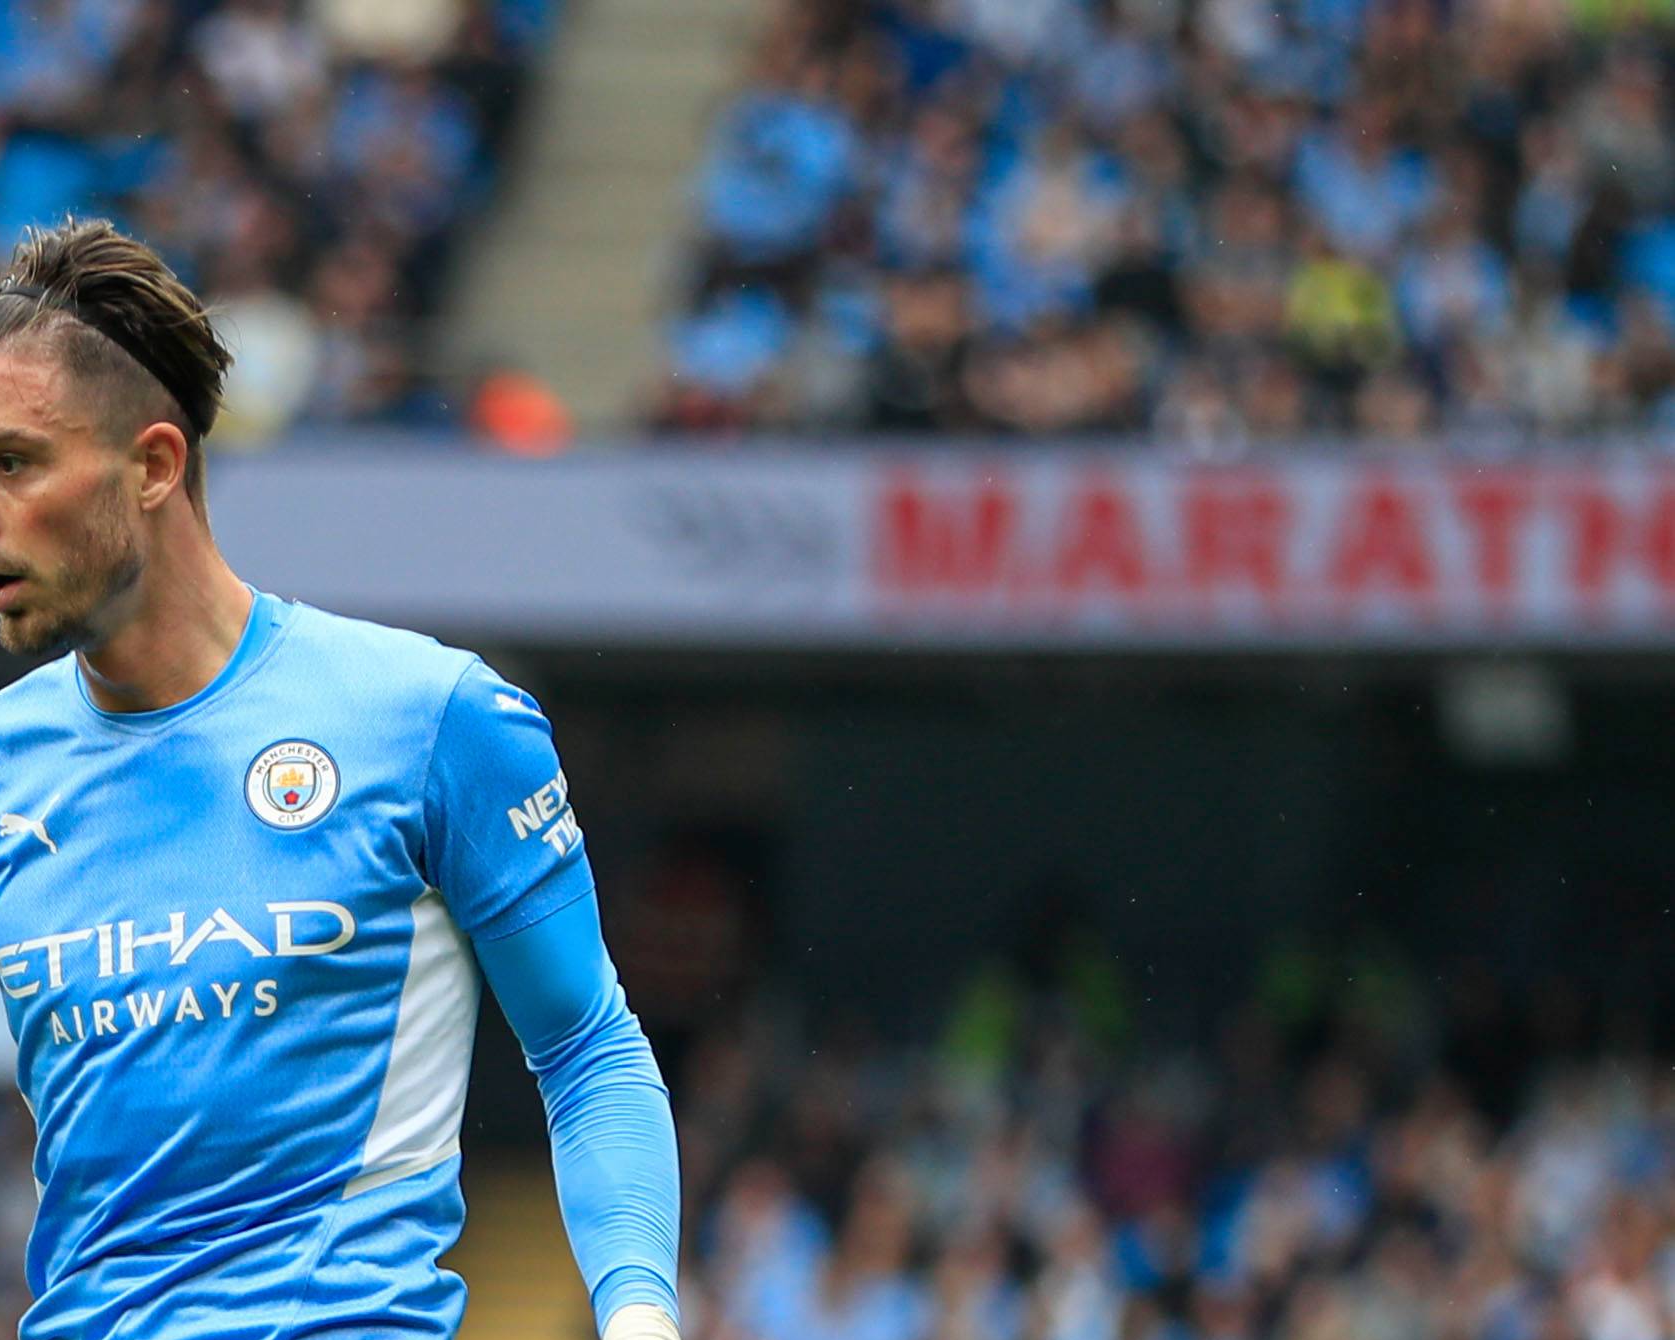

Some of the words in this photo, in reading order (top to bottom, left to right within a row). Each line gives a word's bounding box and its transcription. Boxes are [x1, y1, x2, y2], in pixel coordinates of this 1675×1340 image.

[256, 747, 329, 774] MANCHESTER
[278, 815, 304, 823] CITY
[507, 767, 568, 840] NEX
[50, 979, 278, 1045] AIRWAYS
